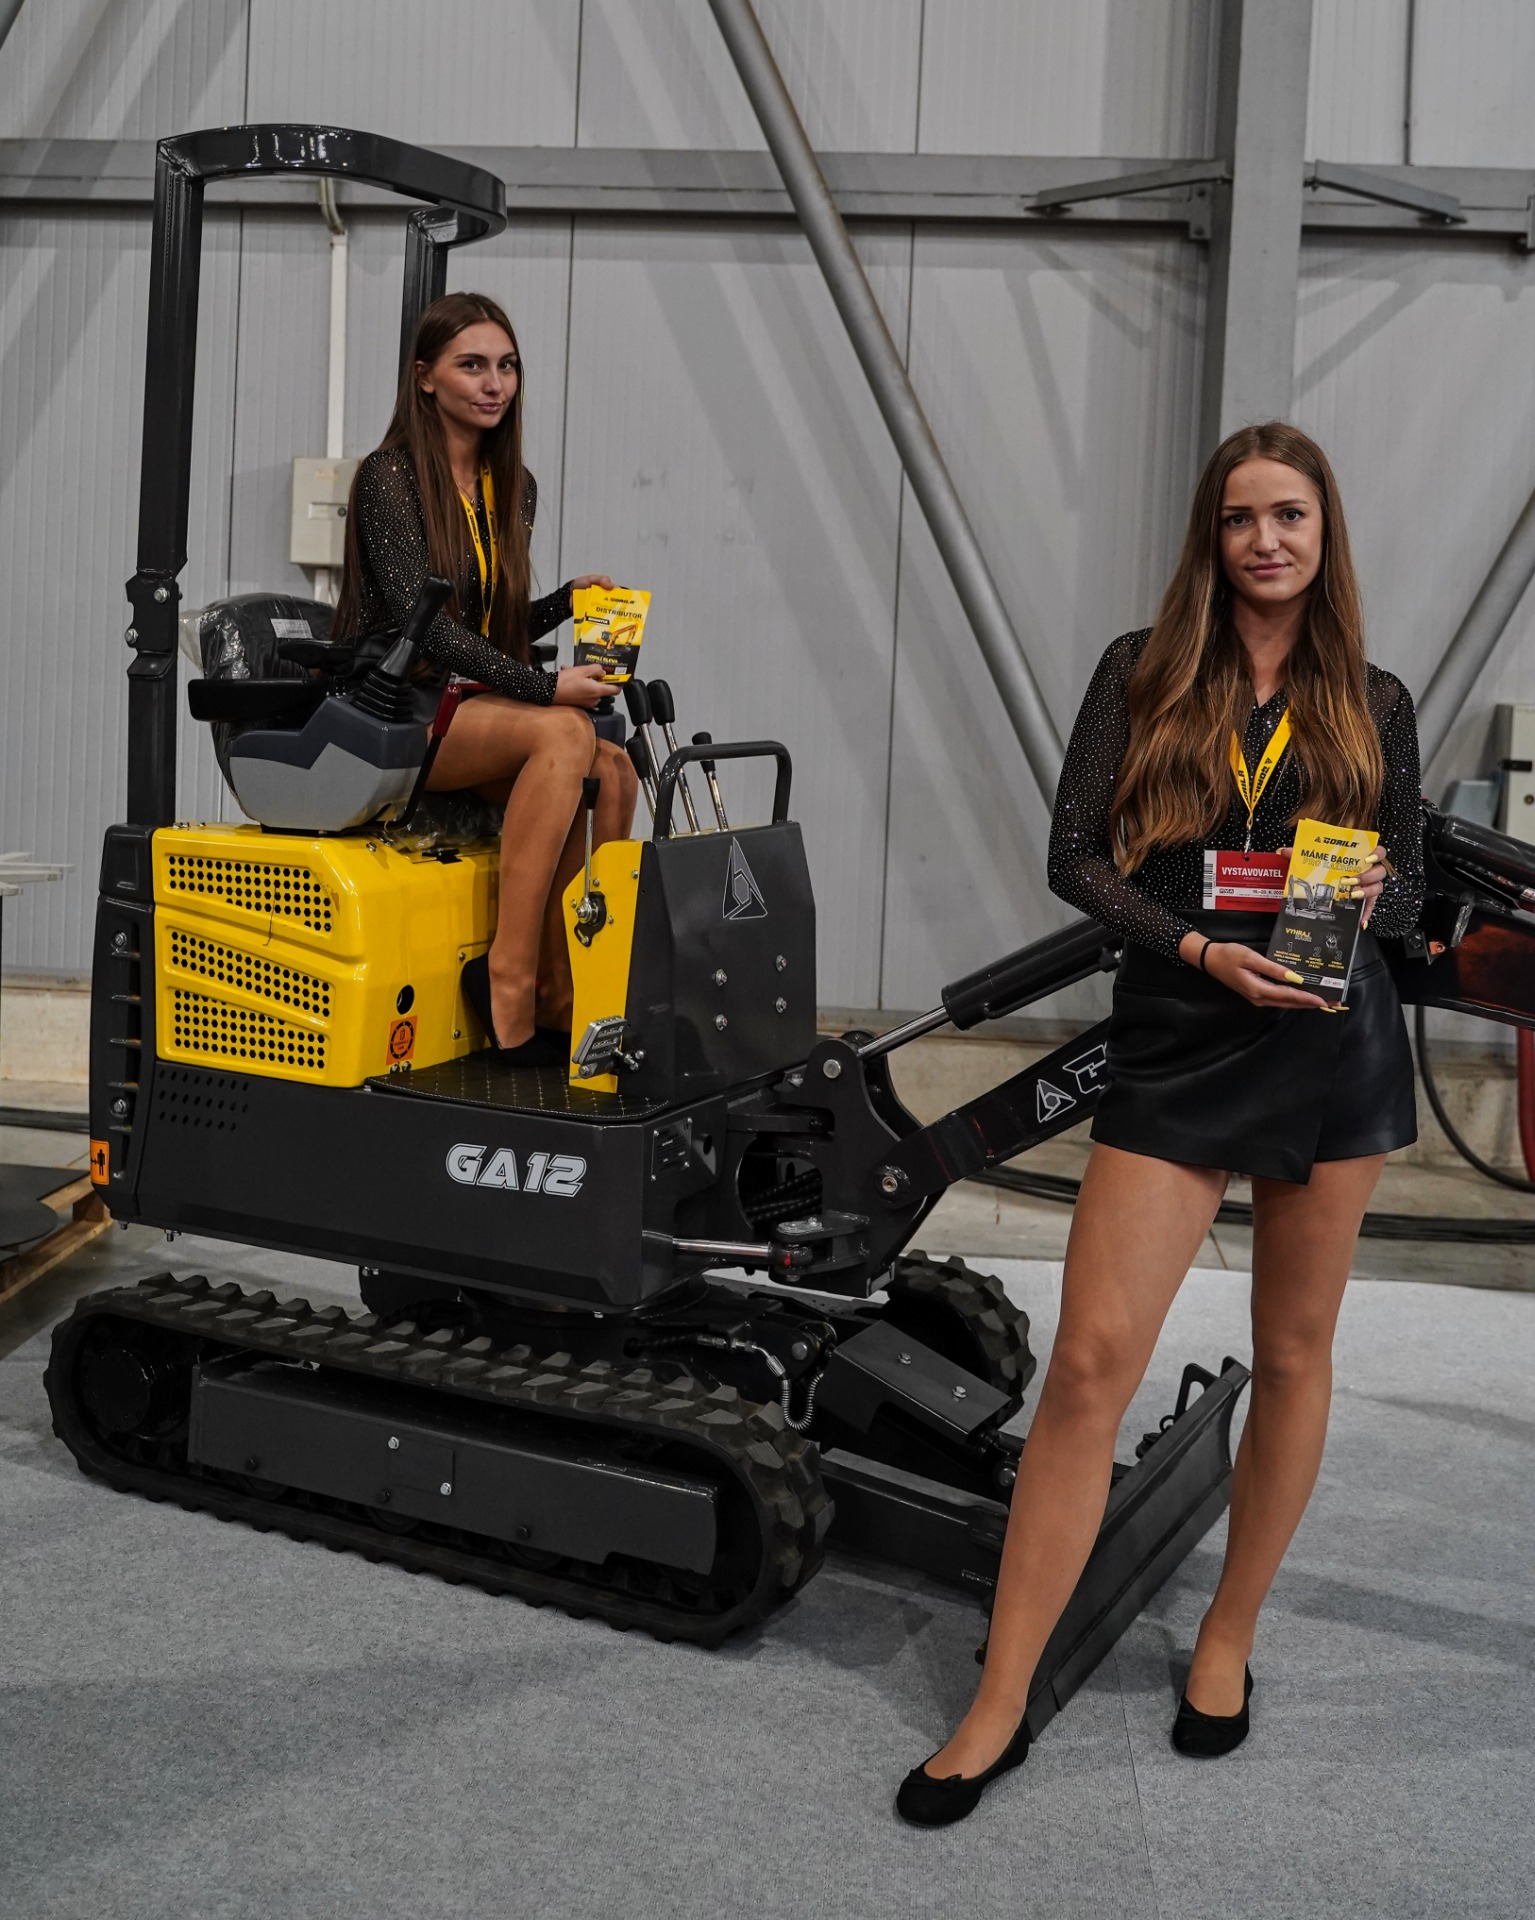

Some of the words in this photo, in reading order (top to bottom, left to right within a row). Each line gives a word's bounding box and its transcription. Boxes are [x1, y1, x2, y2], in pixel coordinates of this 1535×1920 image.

[596, 606, 642, 619] DISTRIBUTOR
[1322, 836, 1357, 848] GORILA
[1300, 848, 1329, 862] MÁME
[1330, 854, 1361, 866] BAGRY
[1221, 866, 1284, 878] VYSTAVOVATEL
[1312, 946, 1322, 958] 2
[445, 1143, 588, 1198] GA12
